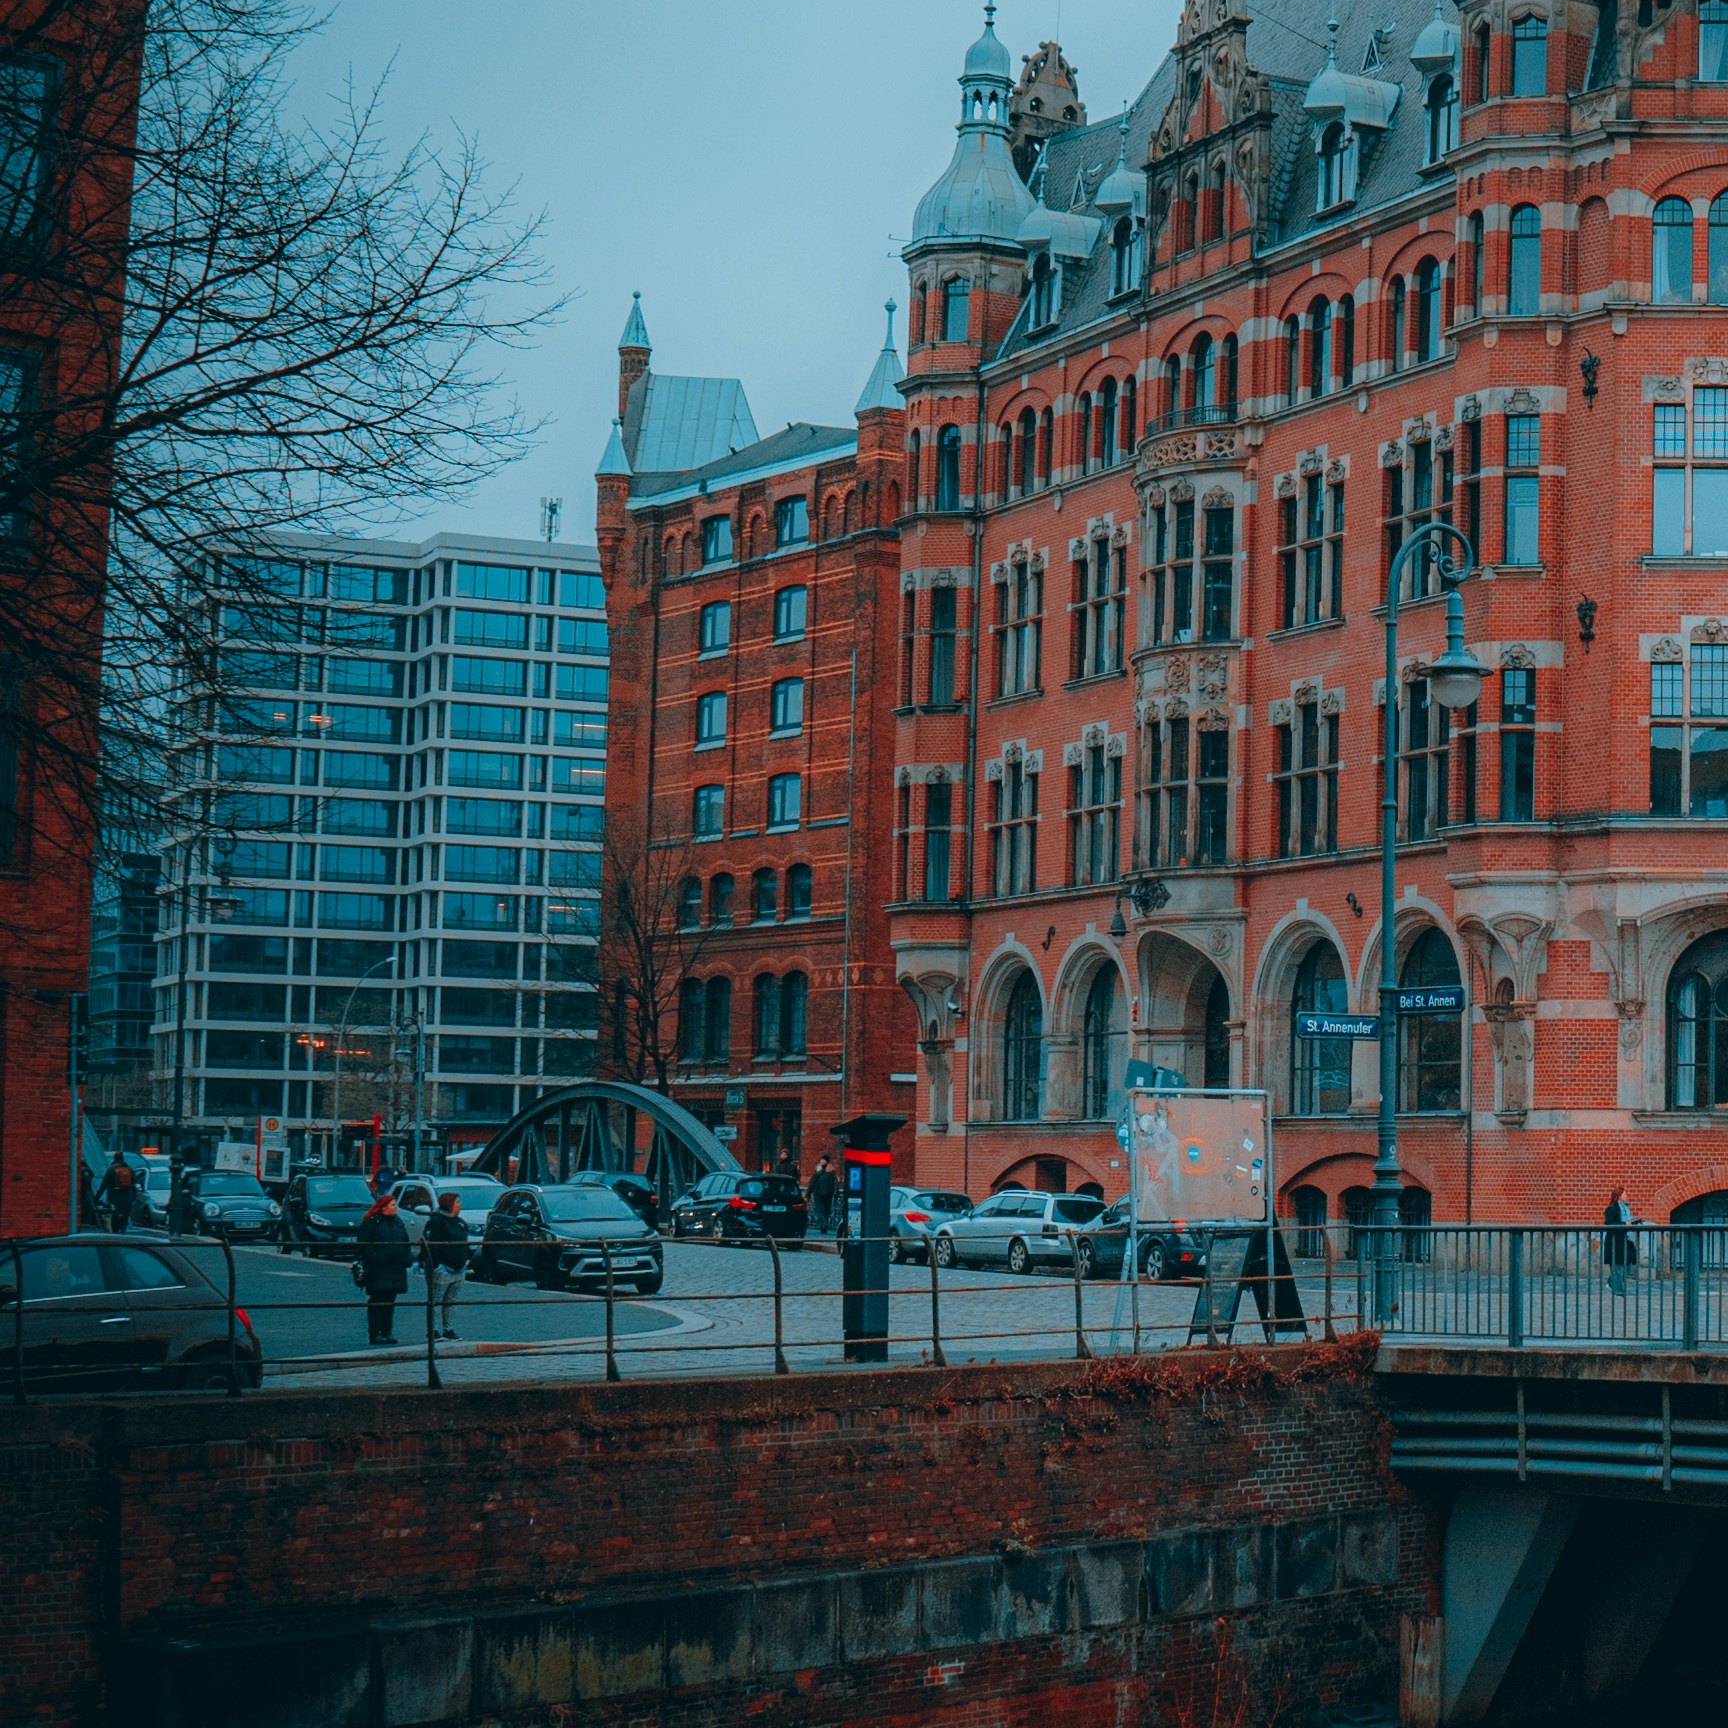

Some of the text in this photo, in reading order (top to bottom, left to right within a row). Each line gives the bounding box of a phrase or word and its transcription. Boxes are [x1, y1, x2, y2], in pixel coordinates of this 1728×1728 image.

[1399, 995, 1456, 1009] Bei St. Annen
[1307, 1019, 1373, 1034] St. Annenufer
[850, 1170, 859, 1186] P
